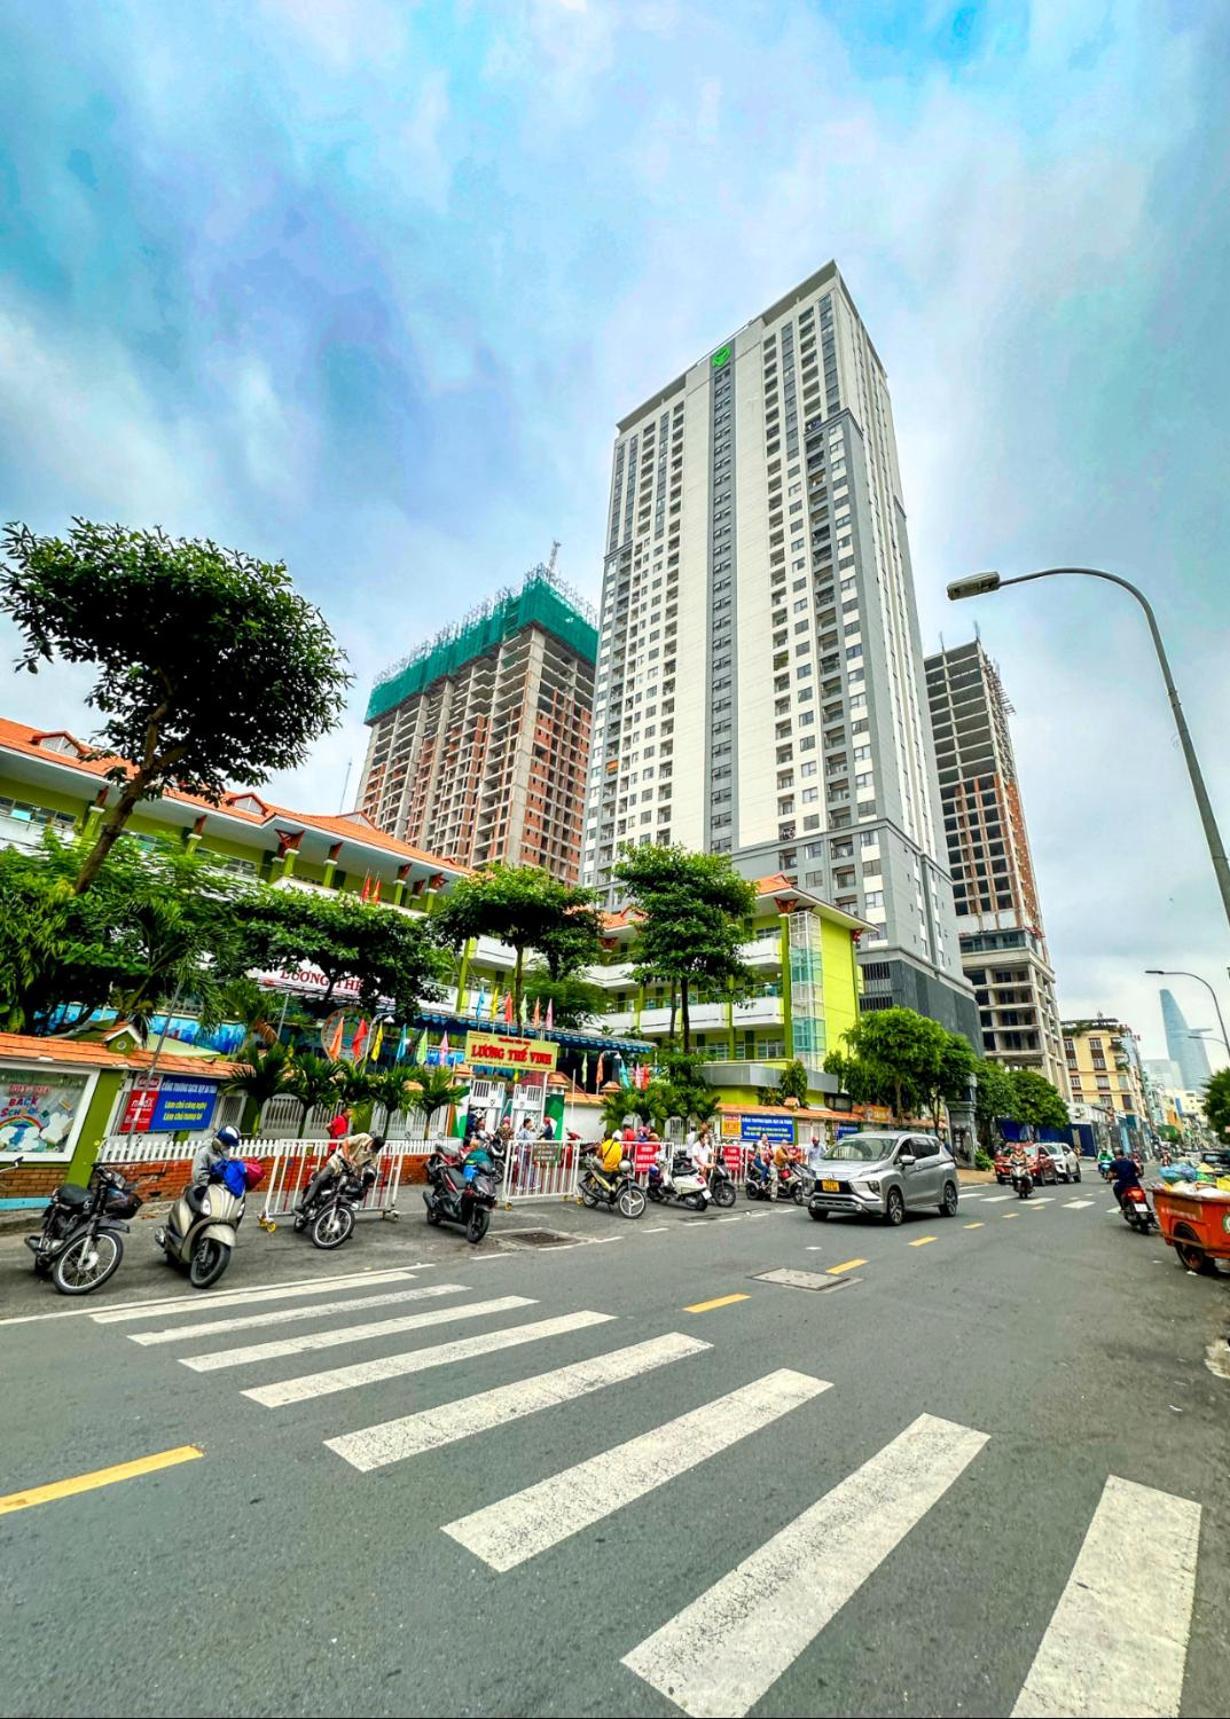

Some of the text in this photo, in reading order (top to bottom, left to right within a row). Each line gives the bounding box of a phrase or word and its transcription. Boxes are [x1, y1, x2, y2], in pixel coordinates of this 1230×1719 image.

[471, 1043, 553, 1065] LƯƠNG THẾ VINH
[9, 1096, 39, 1107] BACK
